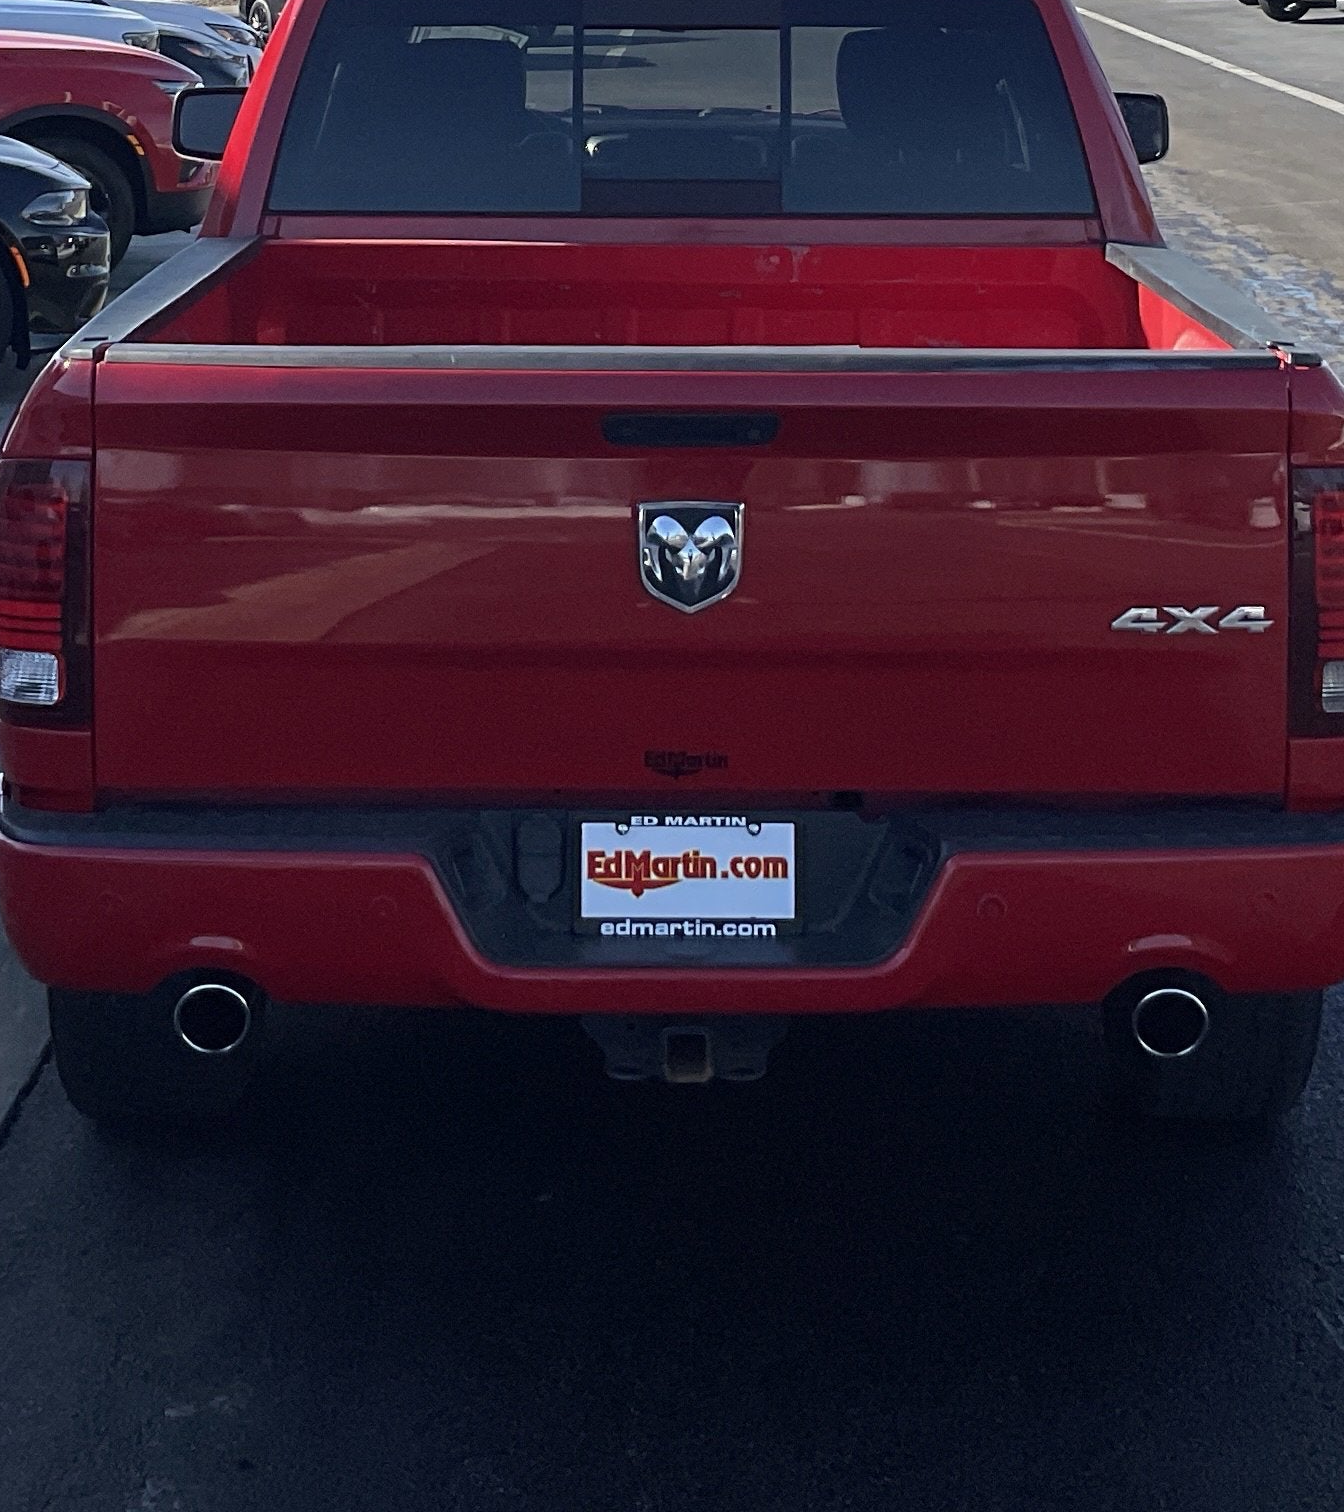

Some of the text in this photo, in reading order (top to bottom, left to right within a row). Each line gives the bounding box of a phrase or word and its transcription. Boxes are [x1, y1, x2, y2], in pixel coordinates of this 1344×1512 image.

[630, 816, 747, 826] ED MARTIN
[600, 919, 777, 936] edmartin.com
